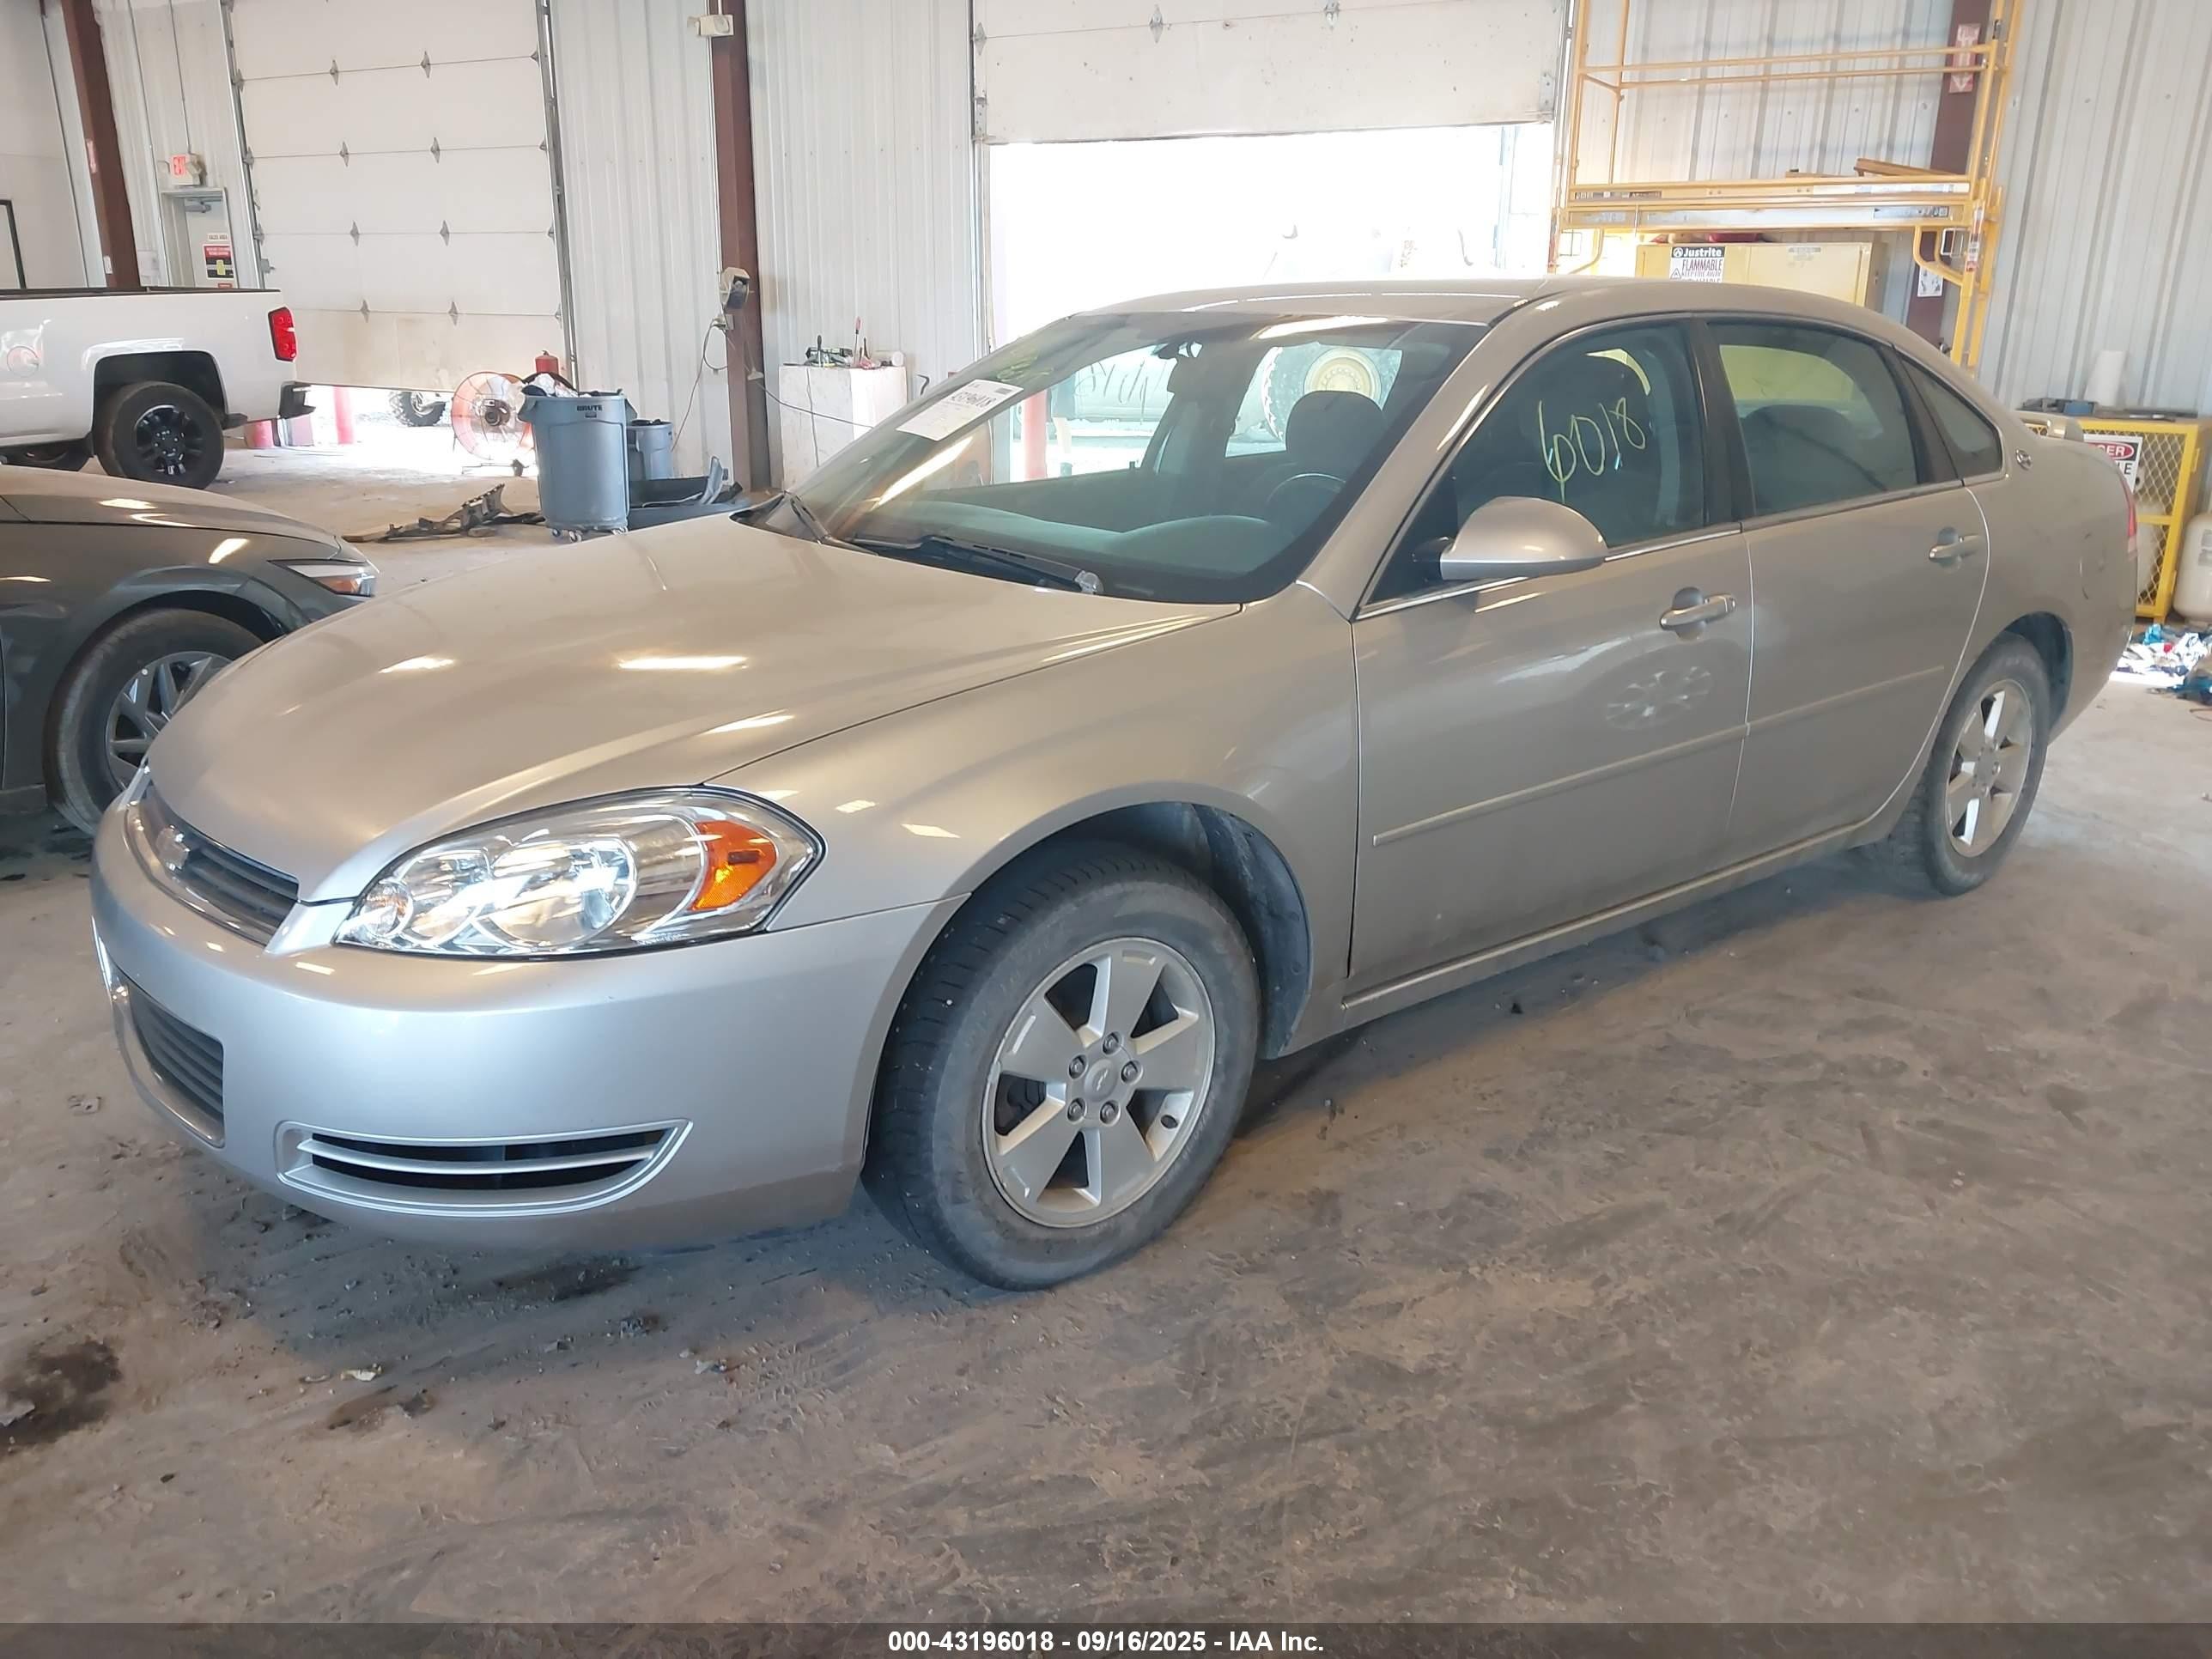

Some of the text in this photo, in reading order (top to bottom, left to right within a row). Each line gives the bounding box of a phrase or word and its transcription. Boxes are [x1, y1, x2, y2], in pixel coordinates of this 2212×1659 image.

[1684, 246, 1722, 257] Justrite
[1682, 258, 1723, 270] FLAMMABLE
[1538, 396, 1646, 483] 6018
